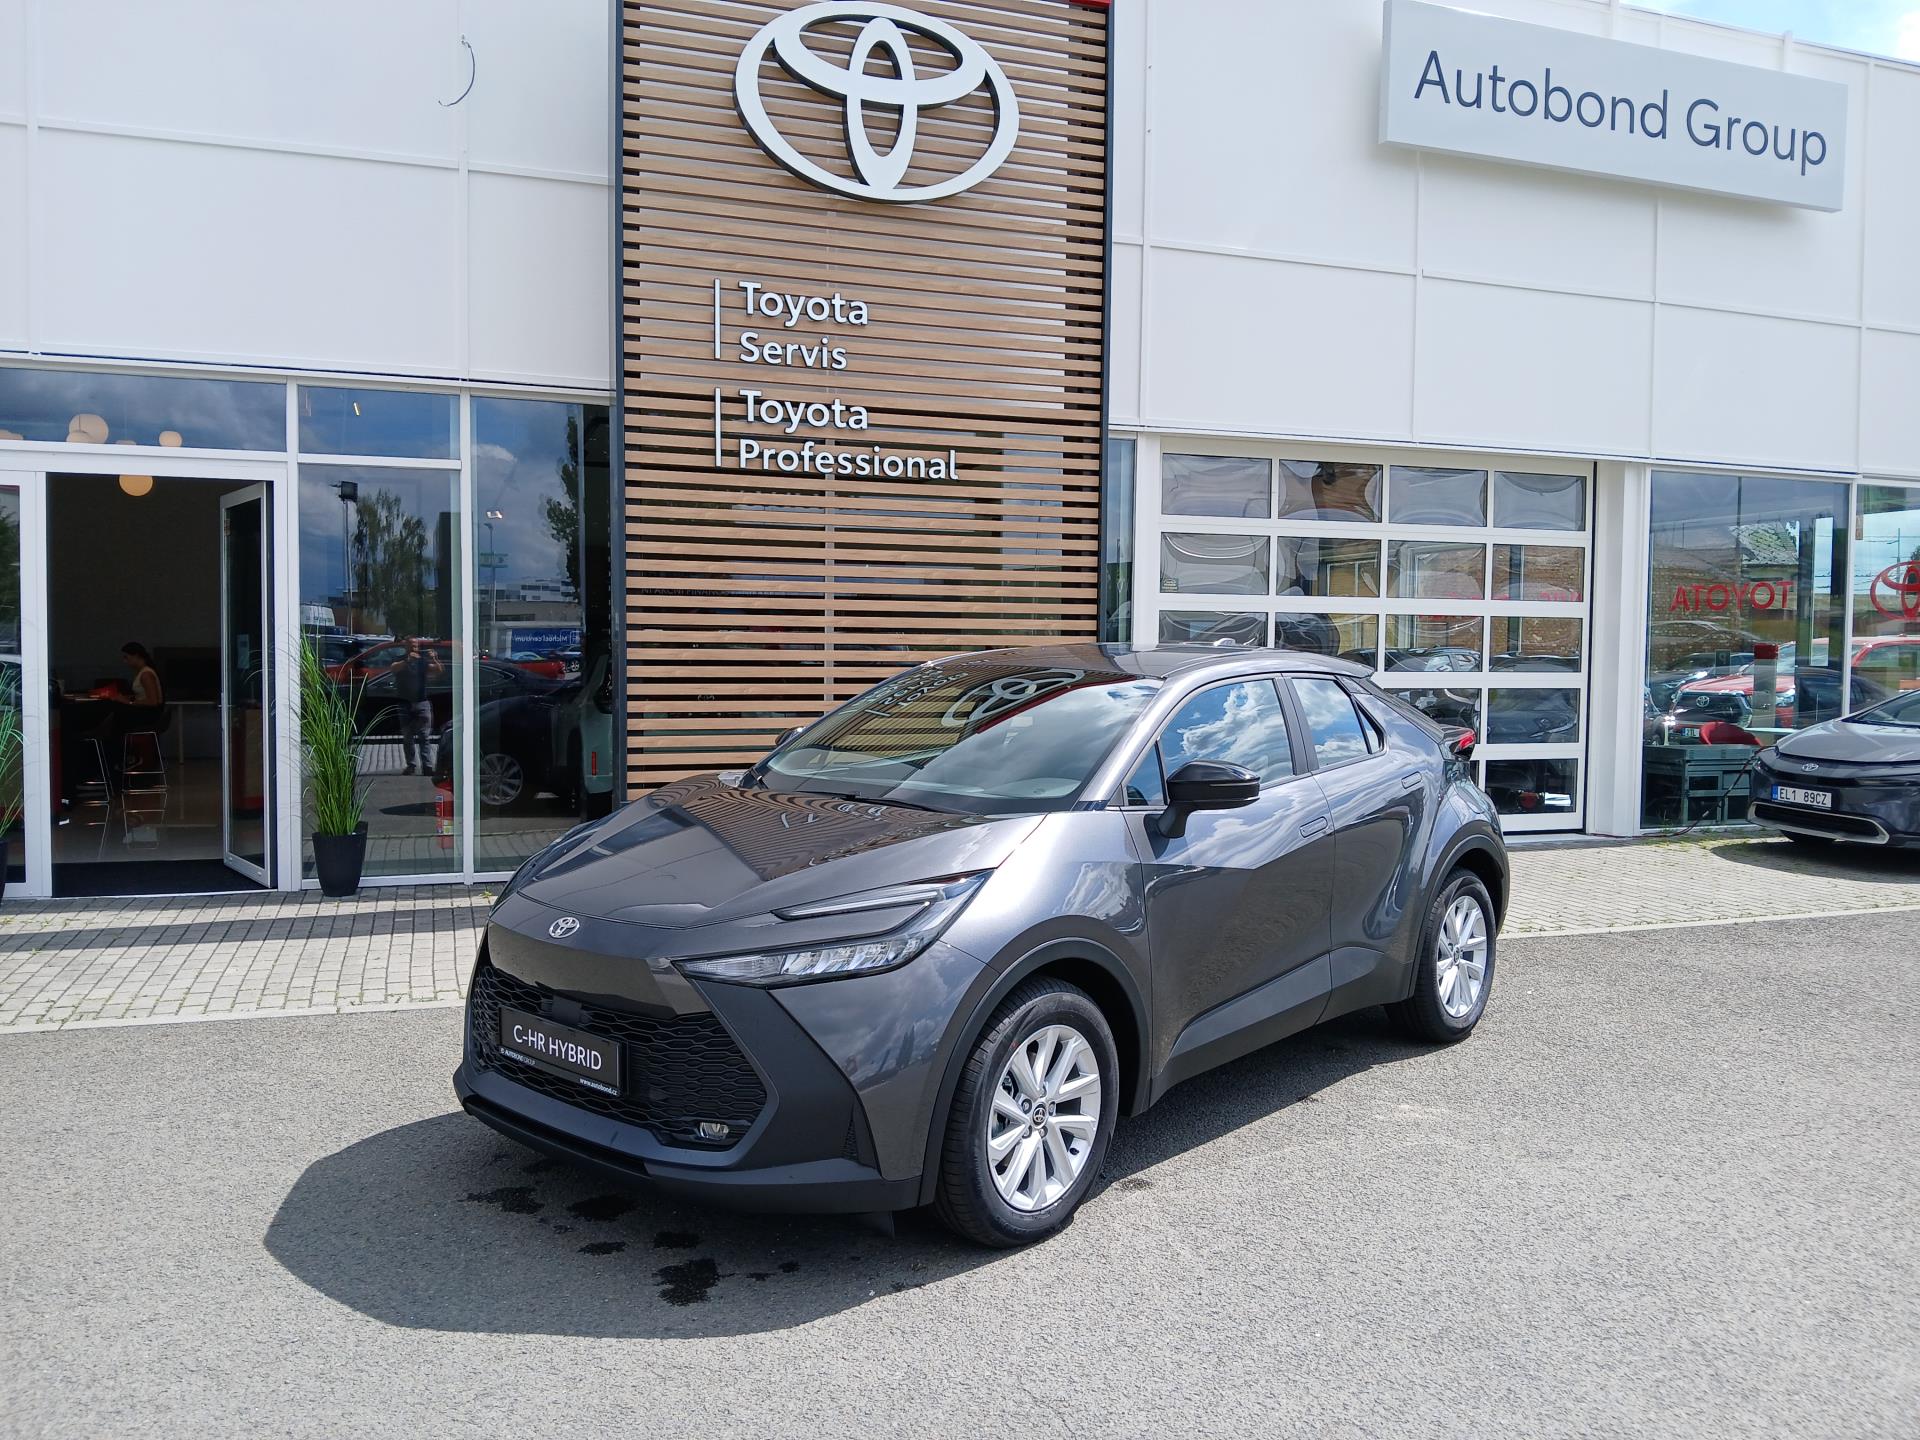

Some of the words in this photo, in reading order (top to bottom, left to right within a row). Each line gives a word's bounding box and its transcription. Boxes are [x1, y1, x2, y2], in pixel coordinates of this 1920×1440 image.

[1414, 49, 1669, 140] Autobond
[1686, 98, 1828, 176] Group
[738, 281, 869, 328] Toyota
[739, 331, 848, 370] Servis
[739, 389, 869, 434] Toyota
[739, 438, 959, 480] Professional
[1779, 787, 1796, 801] EL1
[1803, 791, 1828, 806] 89CZ
[513, 1024, 546, 1053] C-HR
[548, 1036, 602, 1070] HYBRID
